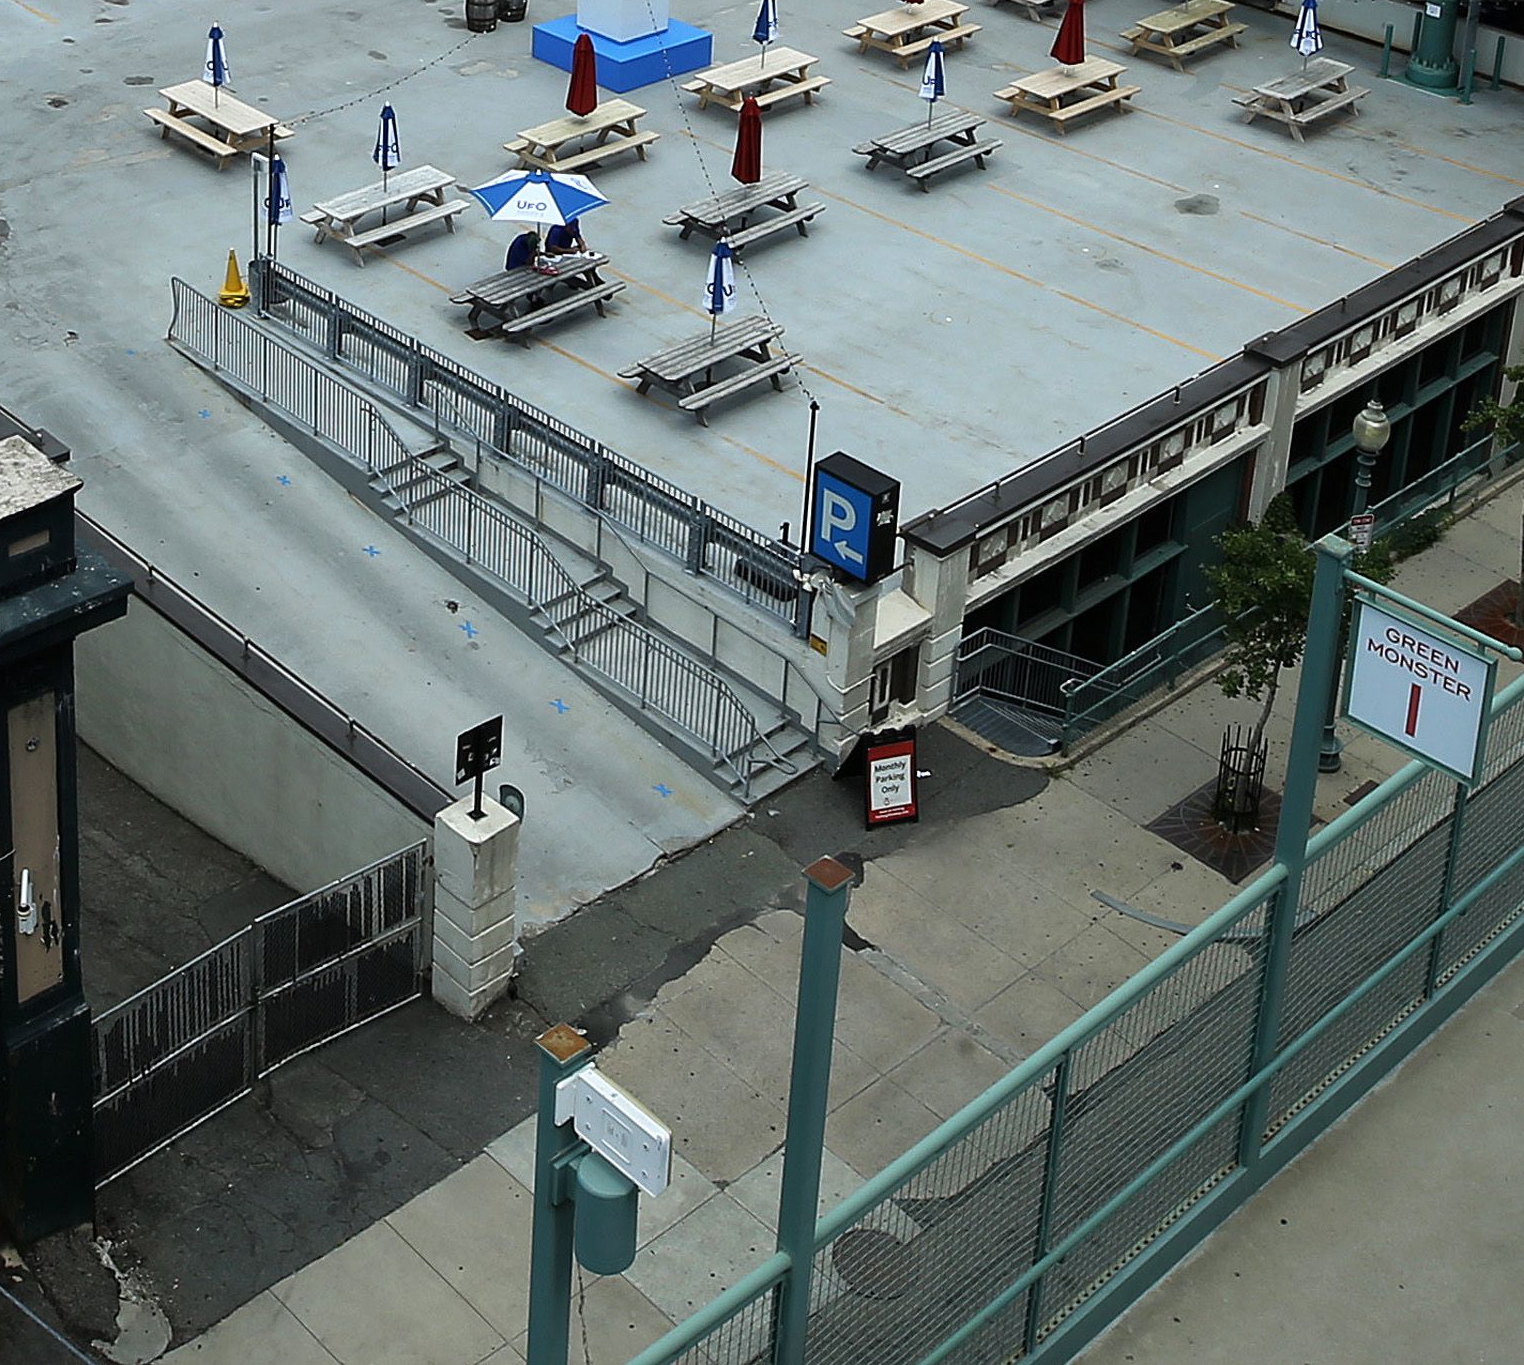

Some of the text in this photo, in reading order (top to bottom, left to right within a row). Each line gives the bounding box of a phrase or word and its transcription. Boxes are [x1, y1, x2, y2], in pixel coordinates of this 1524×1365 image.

[516, 199, 548, 212] UFO
[821, 487, 857, 543] P
[1385, 627, 1460, 675] GREEN
[1367, 637, 1472, 702] MONSTER
[874, 760, 907, 773] Monthly
[875, 772, 906, 784] Parking
[881, 784, 900, 795] Only
